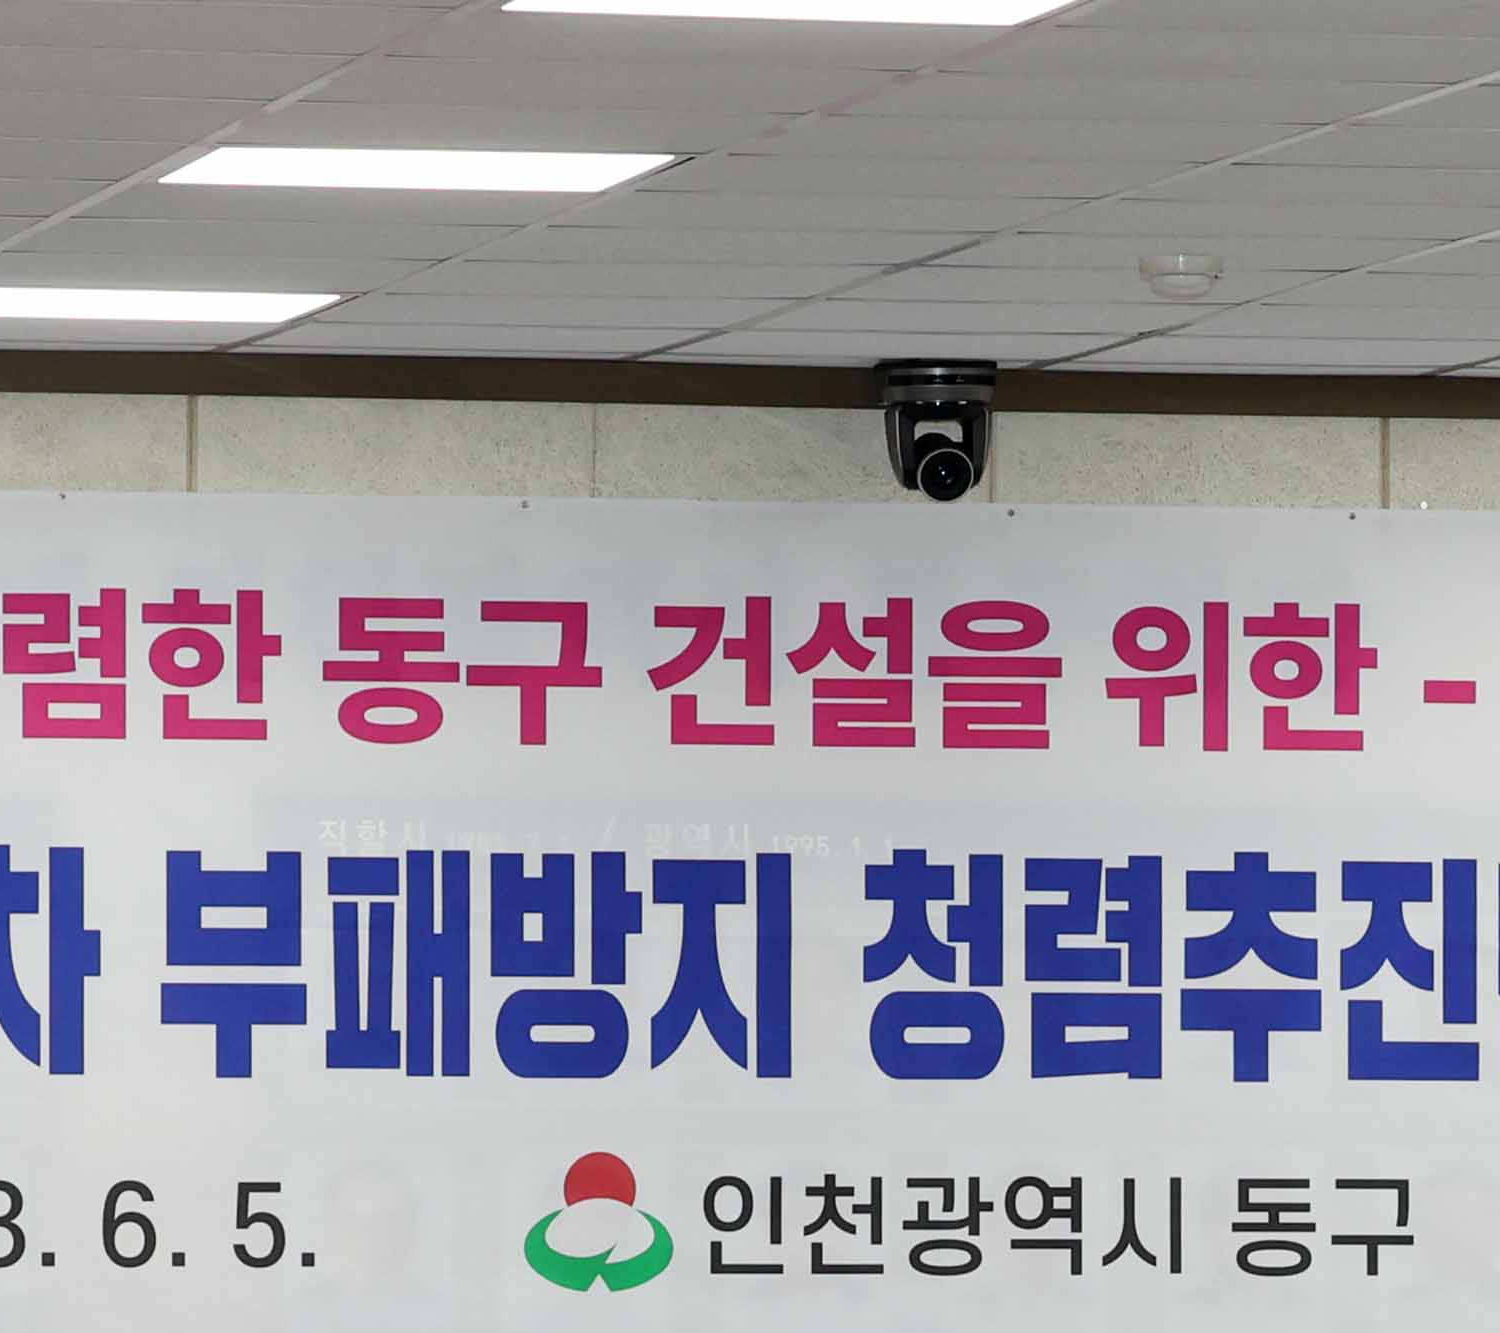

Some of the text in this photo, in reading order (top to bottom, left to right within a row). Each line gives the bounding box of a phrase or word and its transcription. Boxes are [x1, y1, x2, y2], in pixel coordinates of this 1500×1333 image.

[324, 596, 602, 745] 동구
[650, 598, 1060, 749] 건설을
[1108, 602, 1377, 752] 위한
[162, 849, 792, 1079] 부패방지
[102, 1180, 186, 1268] 6.
[233, 1181, 315, 1268] 5.
[703, 1173, 1414, 1278] 인천광역시 동구
